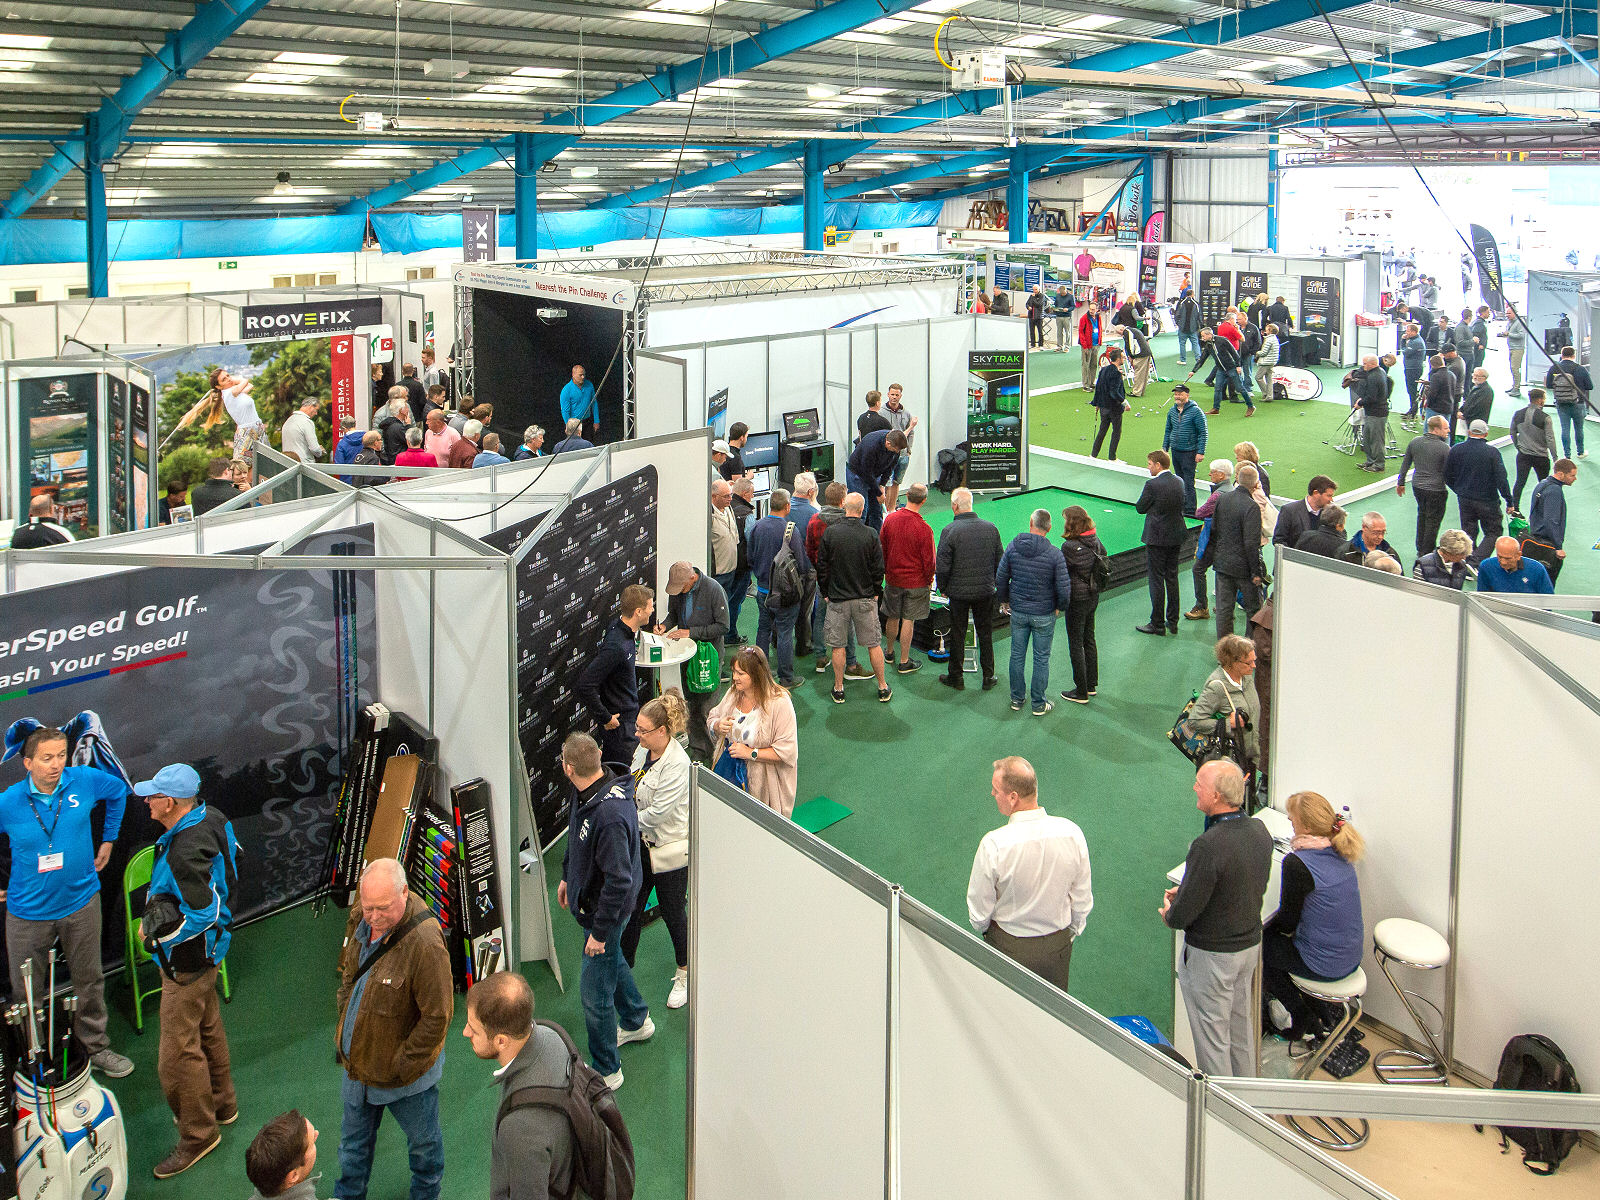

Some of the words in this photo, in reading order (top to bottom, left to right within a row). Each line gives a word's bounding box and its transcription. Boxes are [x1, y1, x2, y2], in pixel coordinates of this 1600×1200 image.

[1127, 183, 1141, 221] Volvik
[535, 281, 557, 293] Nearest
[558, 284, 568, 294] the
[568, 286, 579, 295] Pin
[579, 287, 608, 301] Challenge
[972, 355, 1020, 363] SKYTRAK
[338, 378, 346, 420] COSMA
[135, 595, 198, 627] Golf
[50, 652, 106, 676] Your
[111, 631, 189, 662] Speed!
[79, 1144, 112, 1176] MASTERS
